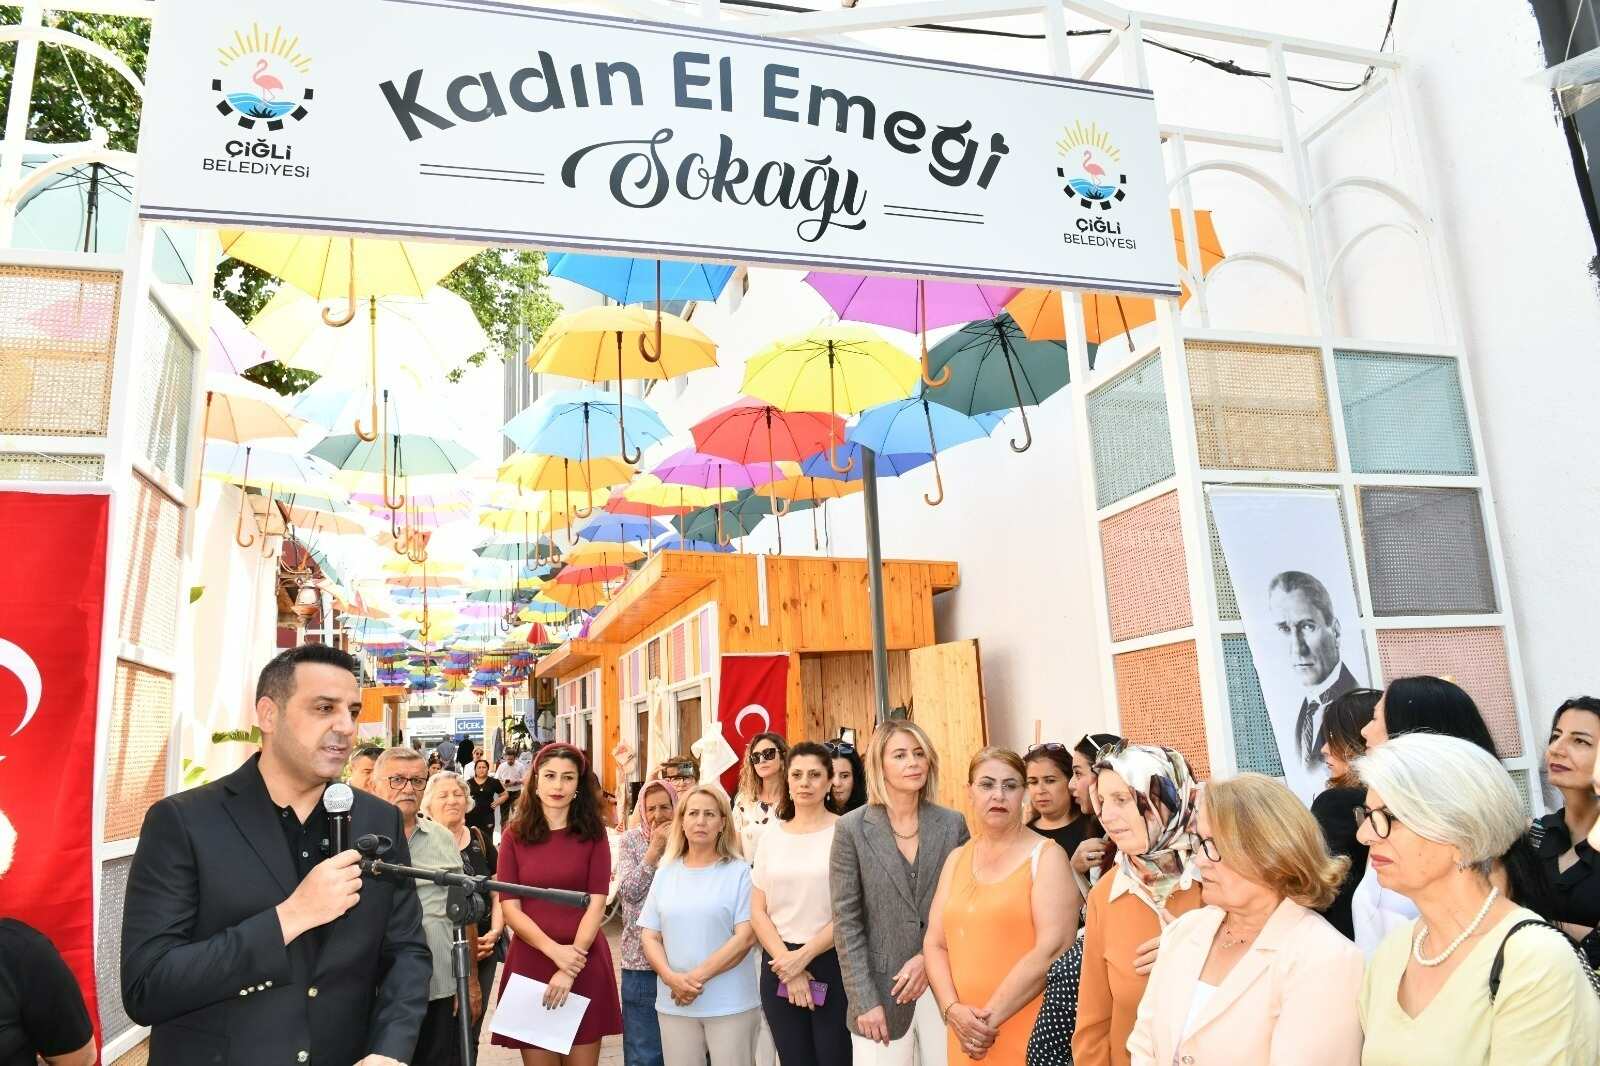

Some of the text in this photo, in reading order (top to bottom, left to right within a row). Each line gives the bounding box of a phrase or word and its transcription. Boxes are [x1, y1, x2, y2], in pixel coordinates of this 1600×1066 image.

[378, 50, 1010, 190] Kadın El Emeği
[561, 128, 867, 243] Sokağı
